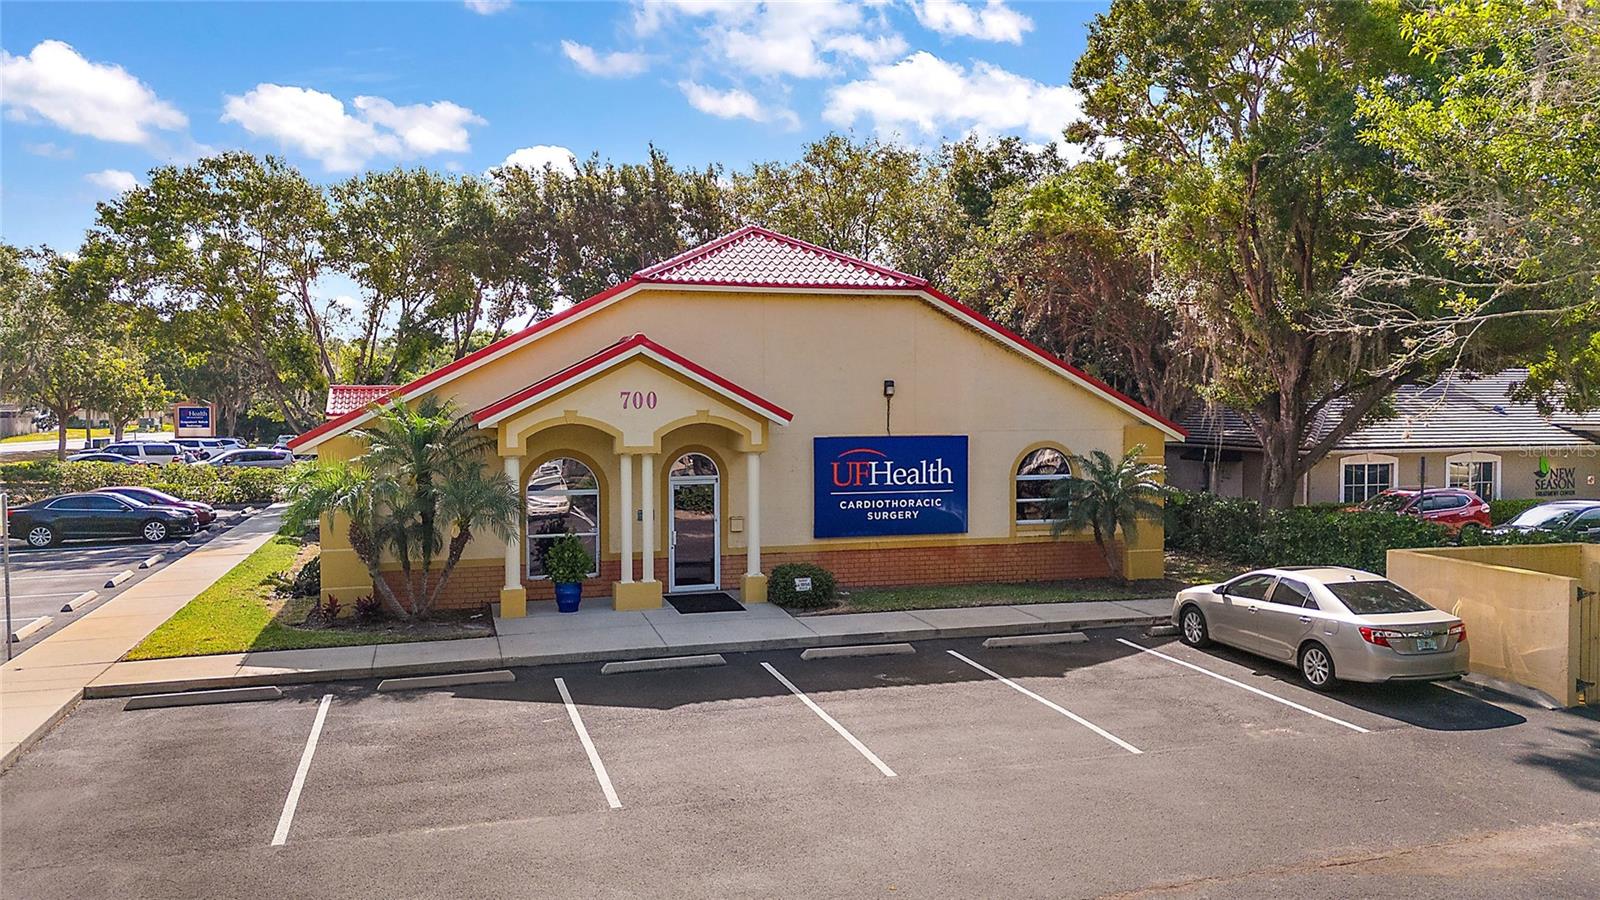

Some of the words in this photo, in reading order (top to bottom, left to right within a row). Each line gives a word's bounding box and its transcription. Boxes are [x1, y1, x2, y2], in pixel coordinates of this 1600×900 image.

[620, 391, 657, 409] 700
[1550, 467, 1575, 479] NEW
[1535, 479, 1575, 490] SEASON
[839, 498, 942, 509] CARDIOTHORACIC
[867, 510, 919, 520] SURGERY
